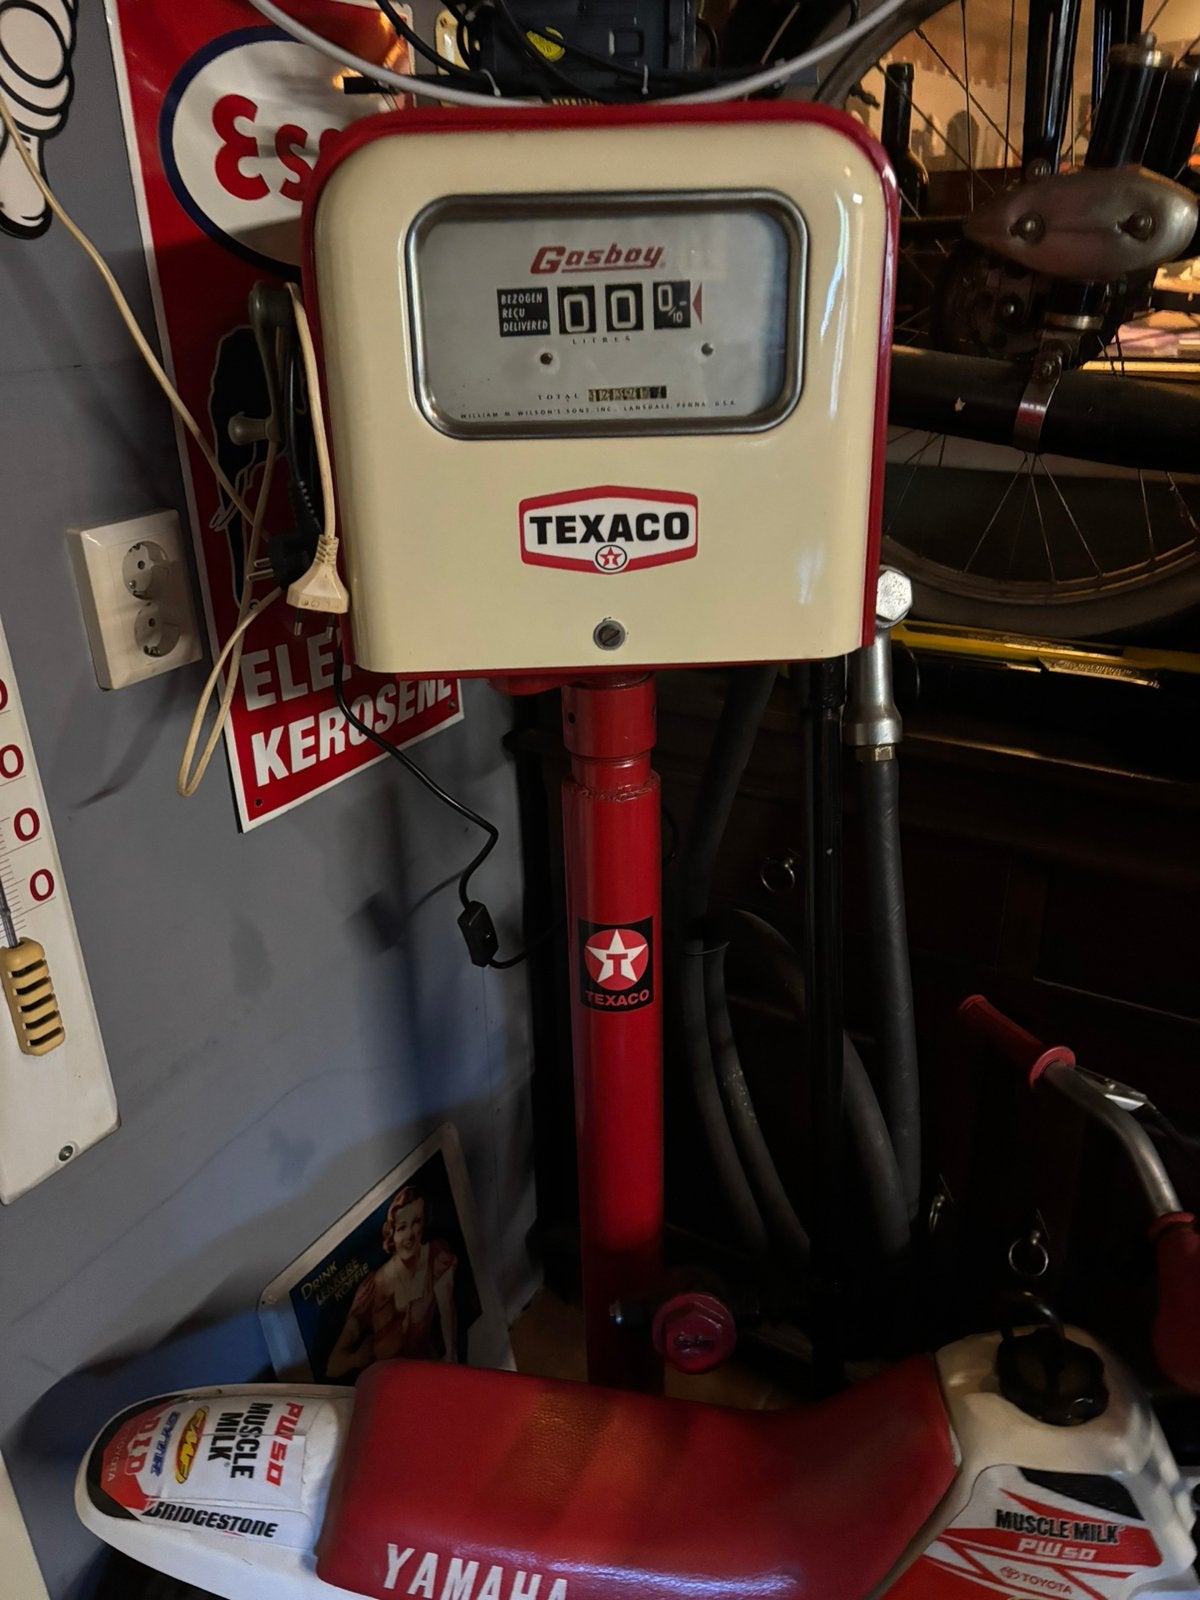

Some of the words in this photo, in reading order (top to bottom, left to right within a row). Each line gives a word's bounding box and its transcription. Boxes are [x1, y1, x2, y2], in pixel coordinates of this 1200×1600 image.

[211, 93, 343, 202] Es
[530, 242, 664, 274] Gasboy
[501, 292, 543, 305] BEZOGEN
[502, 308, 525, 321] REÇU
[503, 320, 548, 332] DELIVERED
[537, 393, 580, 401] TOTAL
[460, 411, 499, 419] WILLIAM
[529, 511, 690, 545] TEXACO
[585, 988, 650, 1006] TEXACO
[300, 1260, 338, 1301] DRINK
[207, 1412, 244, 1462] MILK
[230, 1402, 273, 1479] MUSCLE
[141, 1501, 279, 1538] BRIDGESTONE
[996, 1509, 1070, 1539] MUSCLE
[1073, 1522, 1119, 1543] MILK
[1022, 1573, 1073, 1595] TOYOTA
